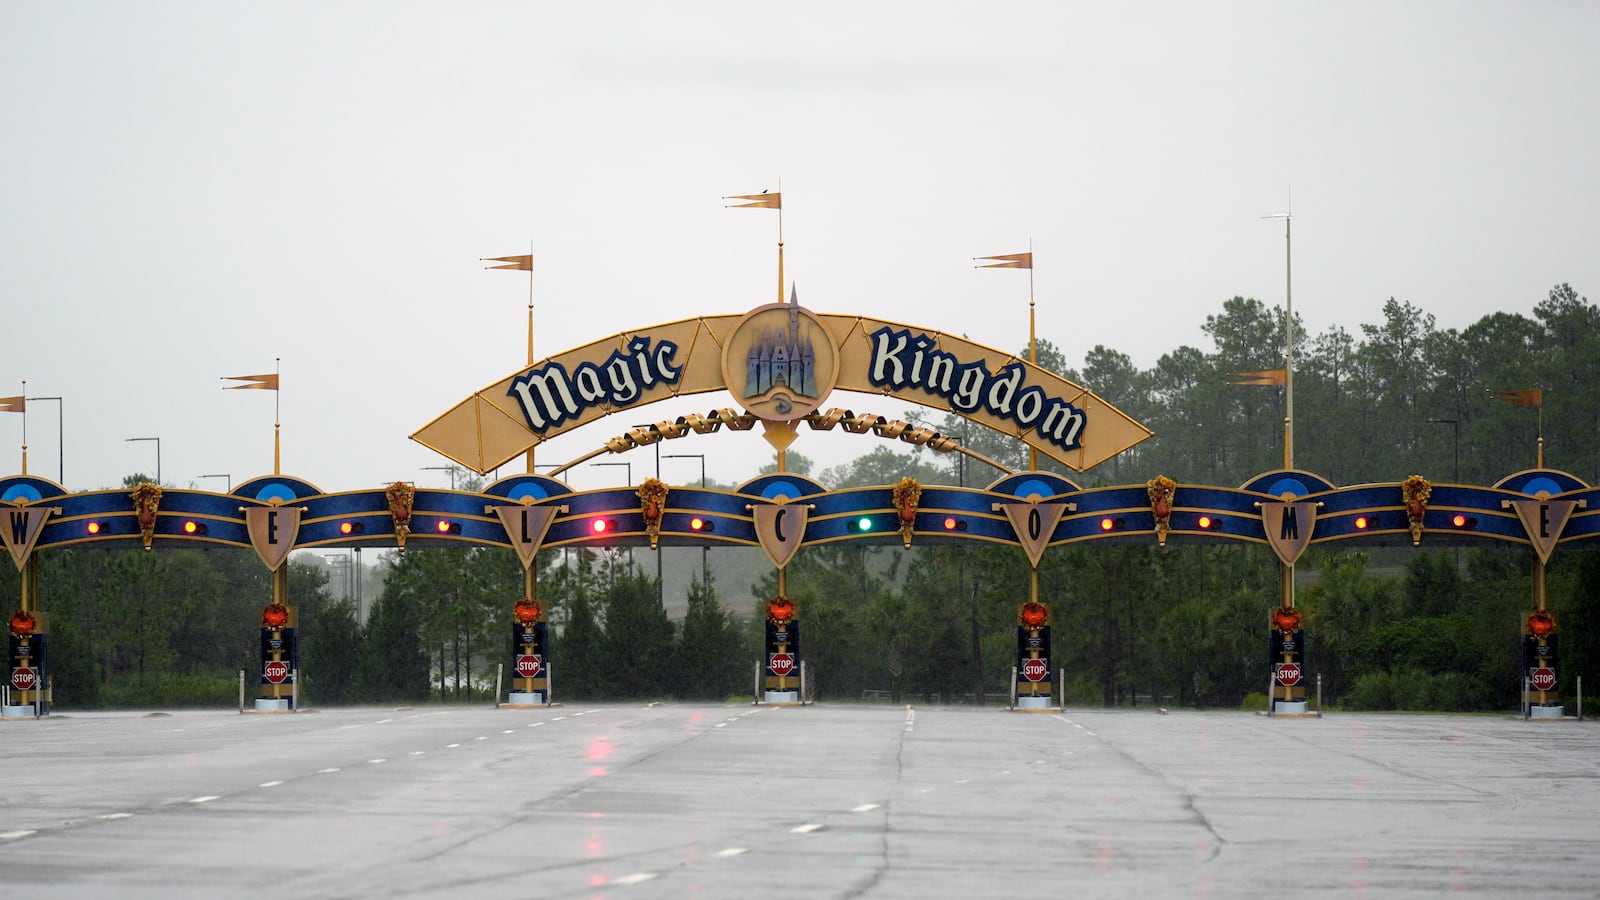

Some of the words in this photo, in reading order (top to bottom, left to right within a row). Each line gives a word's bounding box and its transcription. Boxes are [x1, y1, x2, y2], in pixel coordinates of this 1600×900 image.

[511, 340, 680, 431] Magic
[870, 329, 1085, 449] Kingdom
[519, 661, 539, 671] STOP
[772, 659, 792, 669] STOP
[266, 667, 286, 677] STOP
[1025, 665, 1045, 675] STOP
[1279, 669, 1299, 679] STOP
[14, 674, 34, 683] STOP
[1534, 674, 1553, 684] STOP
